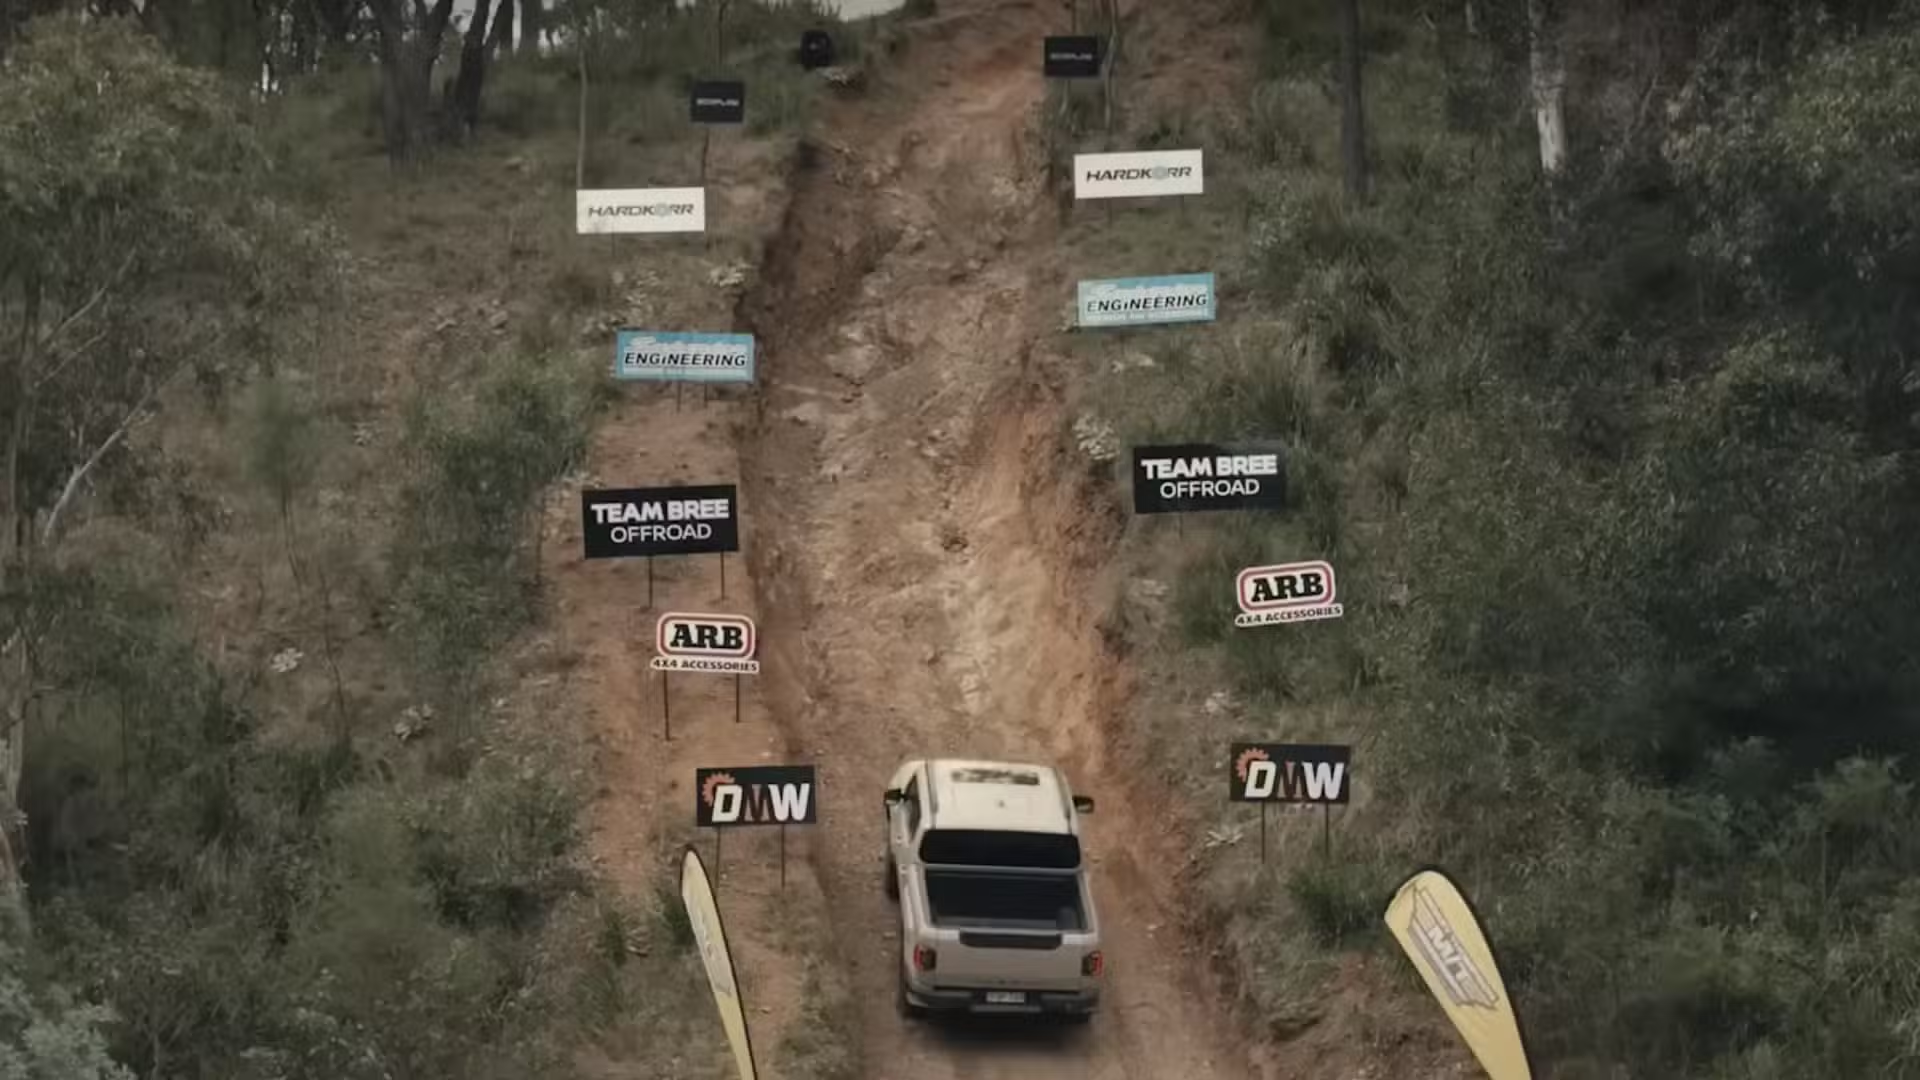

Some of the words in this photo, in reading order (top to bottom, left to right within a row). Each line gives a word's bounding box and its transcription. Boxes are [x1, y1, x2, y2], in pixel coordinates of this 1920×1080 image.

[1140, 457, 1213, 480] TEAM
[1216, 454, 1278, 476] BREE
[1159, 478, 1260, 499] OFFROAD
[590, 501, 664, 524] TEAM
[667, 498, 729, 521] BREE
[610, 523, 712, 543] OFFROAD
[1251, 573, 1324, 602] ARB
[1265, 606, 1341, 622] ACCESSORIES
[669, 623, 744, 649] ARB
[681, 660, 757, 671] ACCESSORIES
